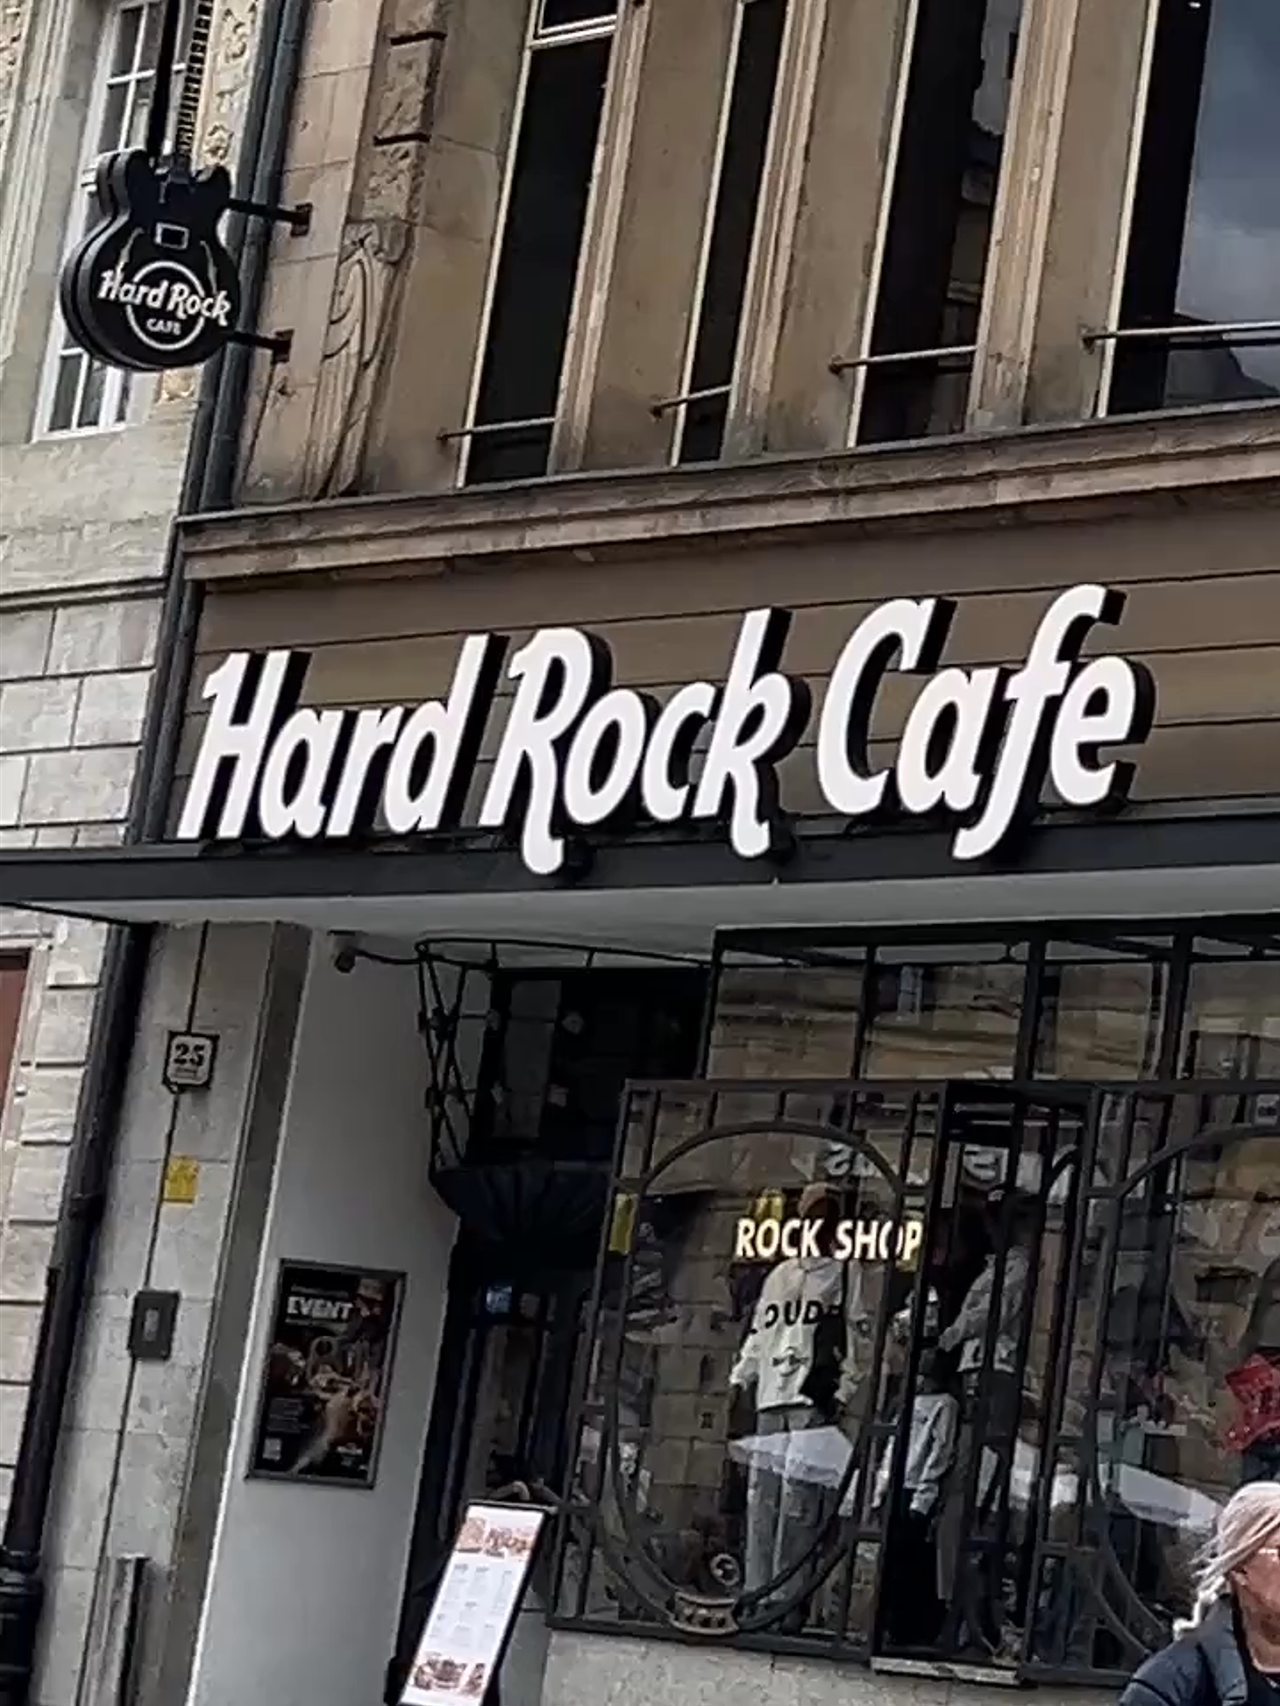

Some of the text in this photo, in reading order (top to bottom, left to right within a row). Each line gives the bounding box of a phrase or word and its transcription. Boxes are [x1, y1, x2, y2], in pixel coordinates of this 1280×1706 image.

[97, 270, 231, 327] Hard Rock
[176, 583, 1140, 876] Hard Rock Cafe
[174, 1043, 205, 1067] 25
[735, 1218, 825, 1258] ROCK
[286, 1296, 354, 1320] EVENT
